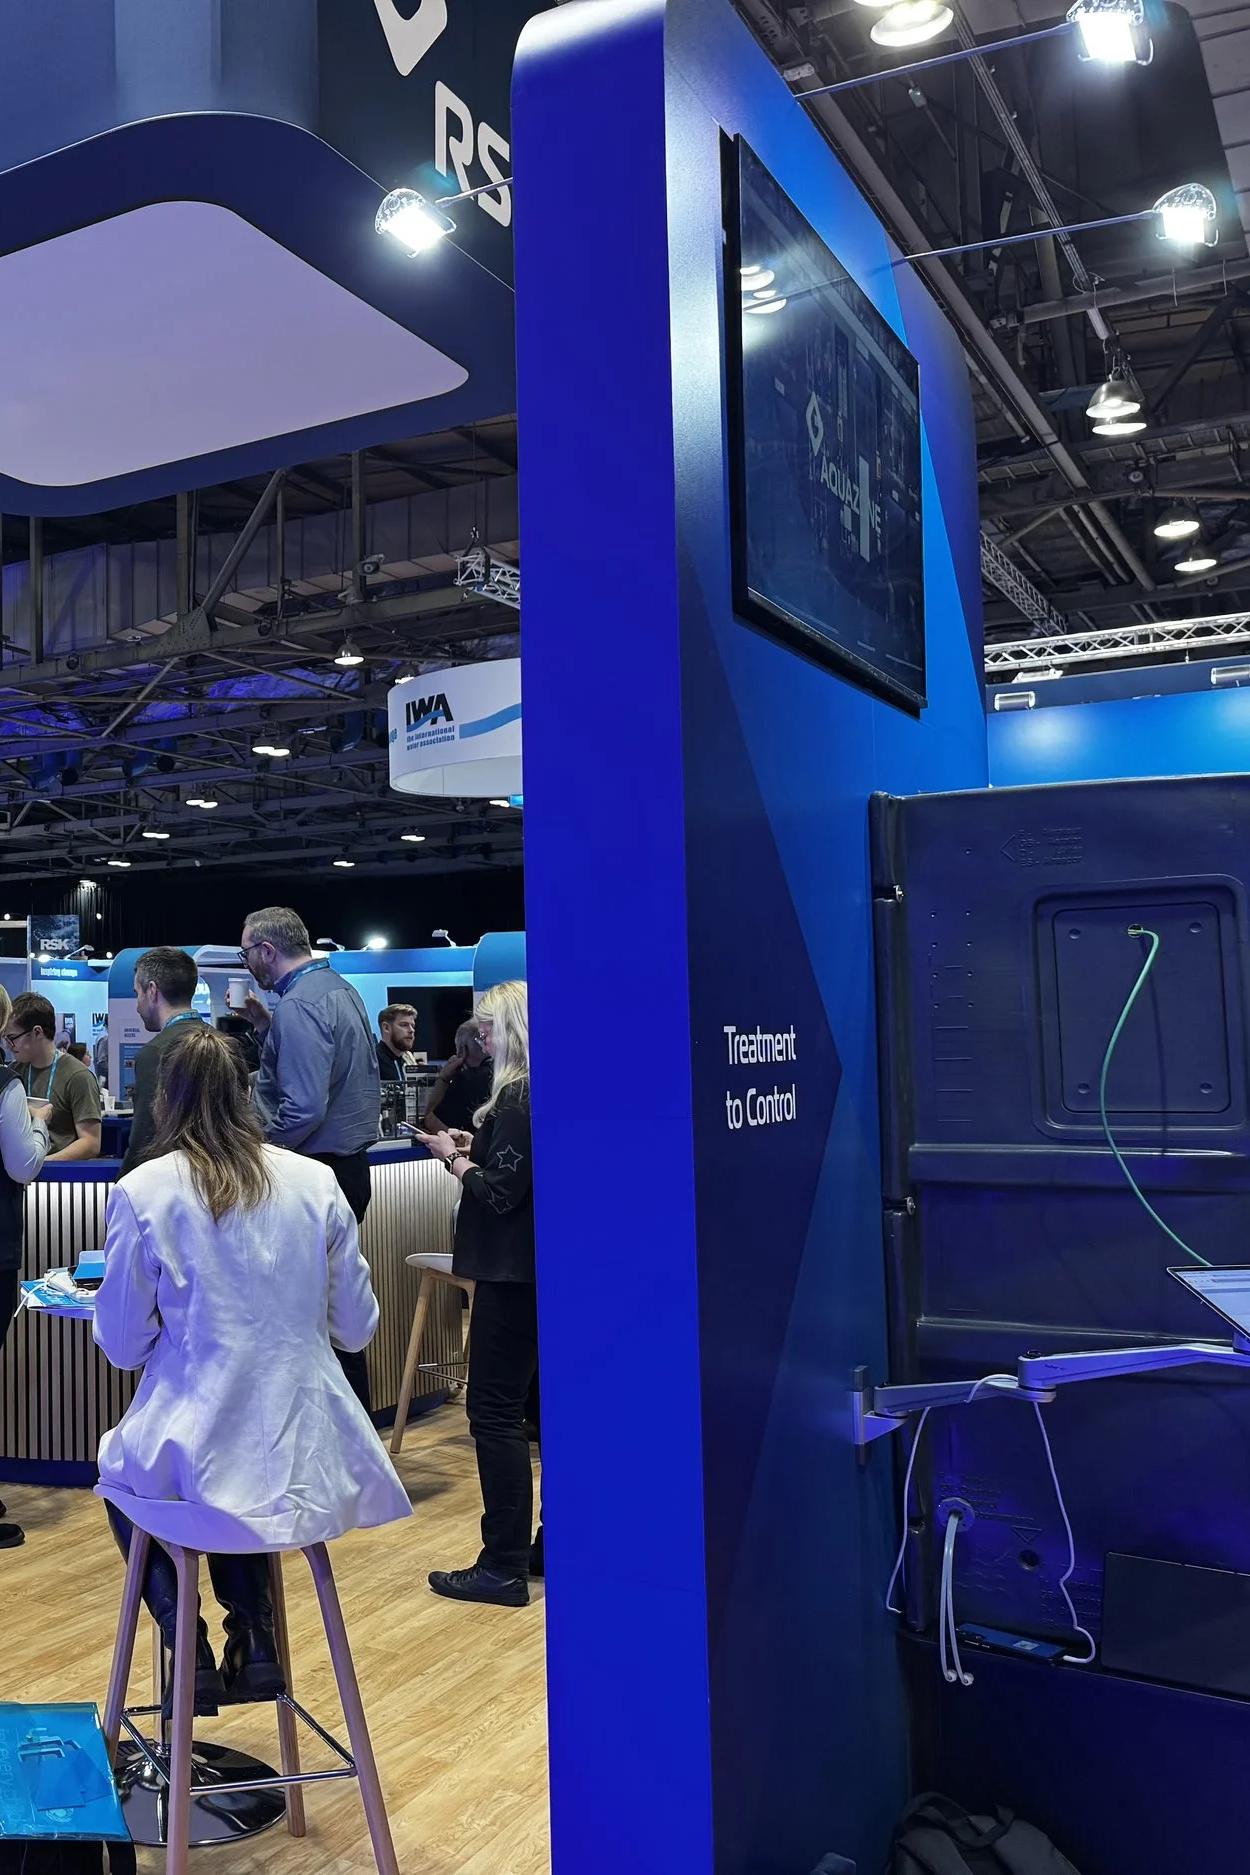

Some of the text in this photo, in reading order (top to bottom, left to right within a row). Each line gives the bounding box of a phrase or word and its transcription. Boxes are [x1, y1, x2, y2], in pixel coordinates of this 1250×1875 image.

[435, 80, 511, 227] RS
[820, 455, 881, 535] AQUAZNE
[405, 692, 454, 730] IWA
[414, 725, 455, 740] international
[419, 735, 455, 748] association
[40, 938, 70, 951] RSK
[723, 1024, 797, 1065] Treatment
[726, 1083, 797, 1130] to Control
